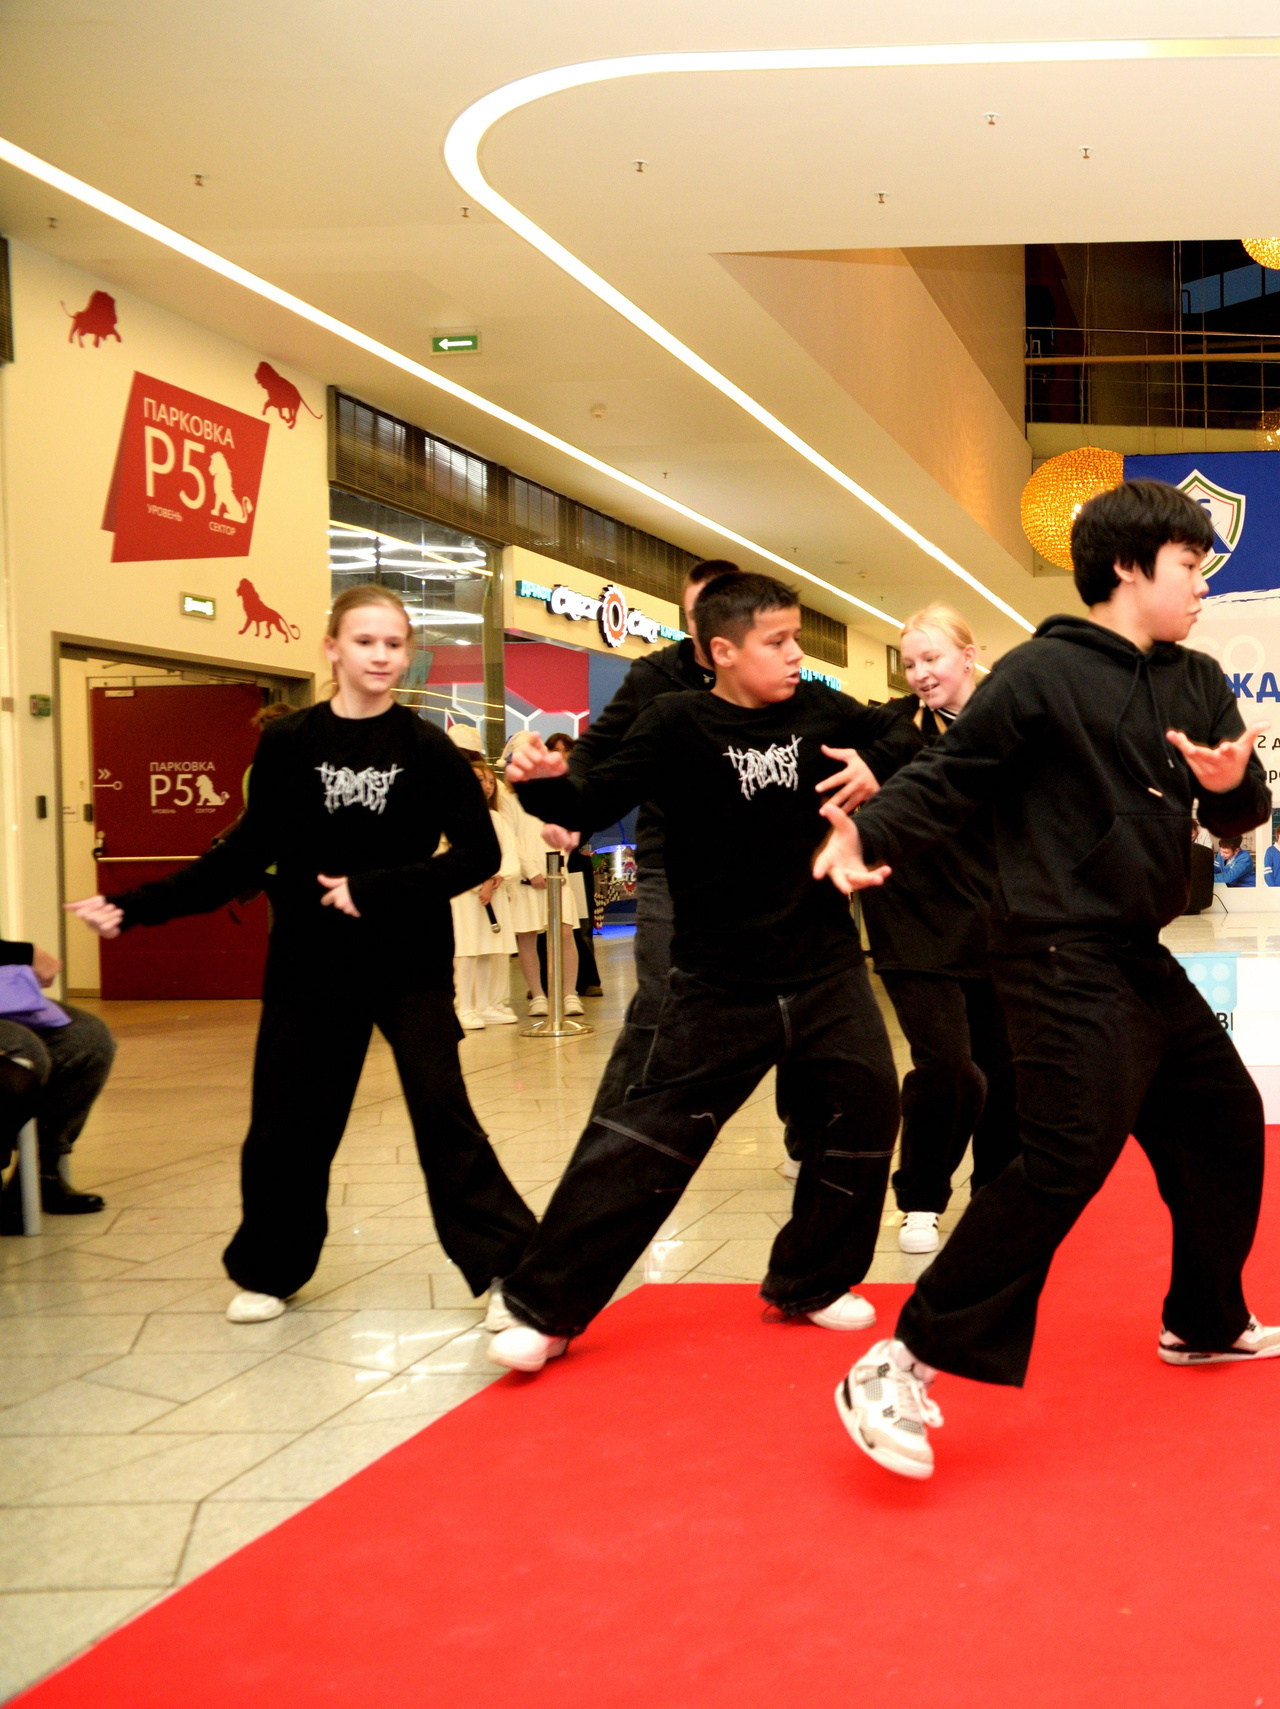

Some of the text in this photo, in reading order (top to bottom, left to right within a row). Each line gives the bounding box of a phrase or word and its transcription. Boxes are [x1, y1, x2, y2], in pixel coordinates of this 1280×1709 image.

[143, 396, 236, 450] ПАРКОВКА
[144, 424, 206, 510] P5
[146, 503, 184, 522] УРОВЕНЬ
[208, 520, 237, 536] СЕКТОР
[149, 761, 216, 772] ПАРКОВКА
[150, 773, 194, 807] P5
